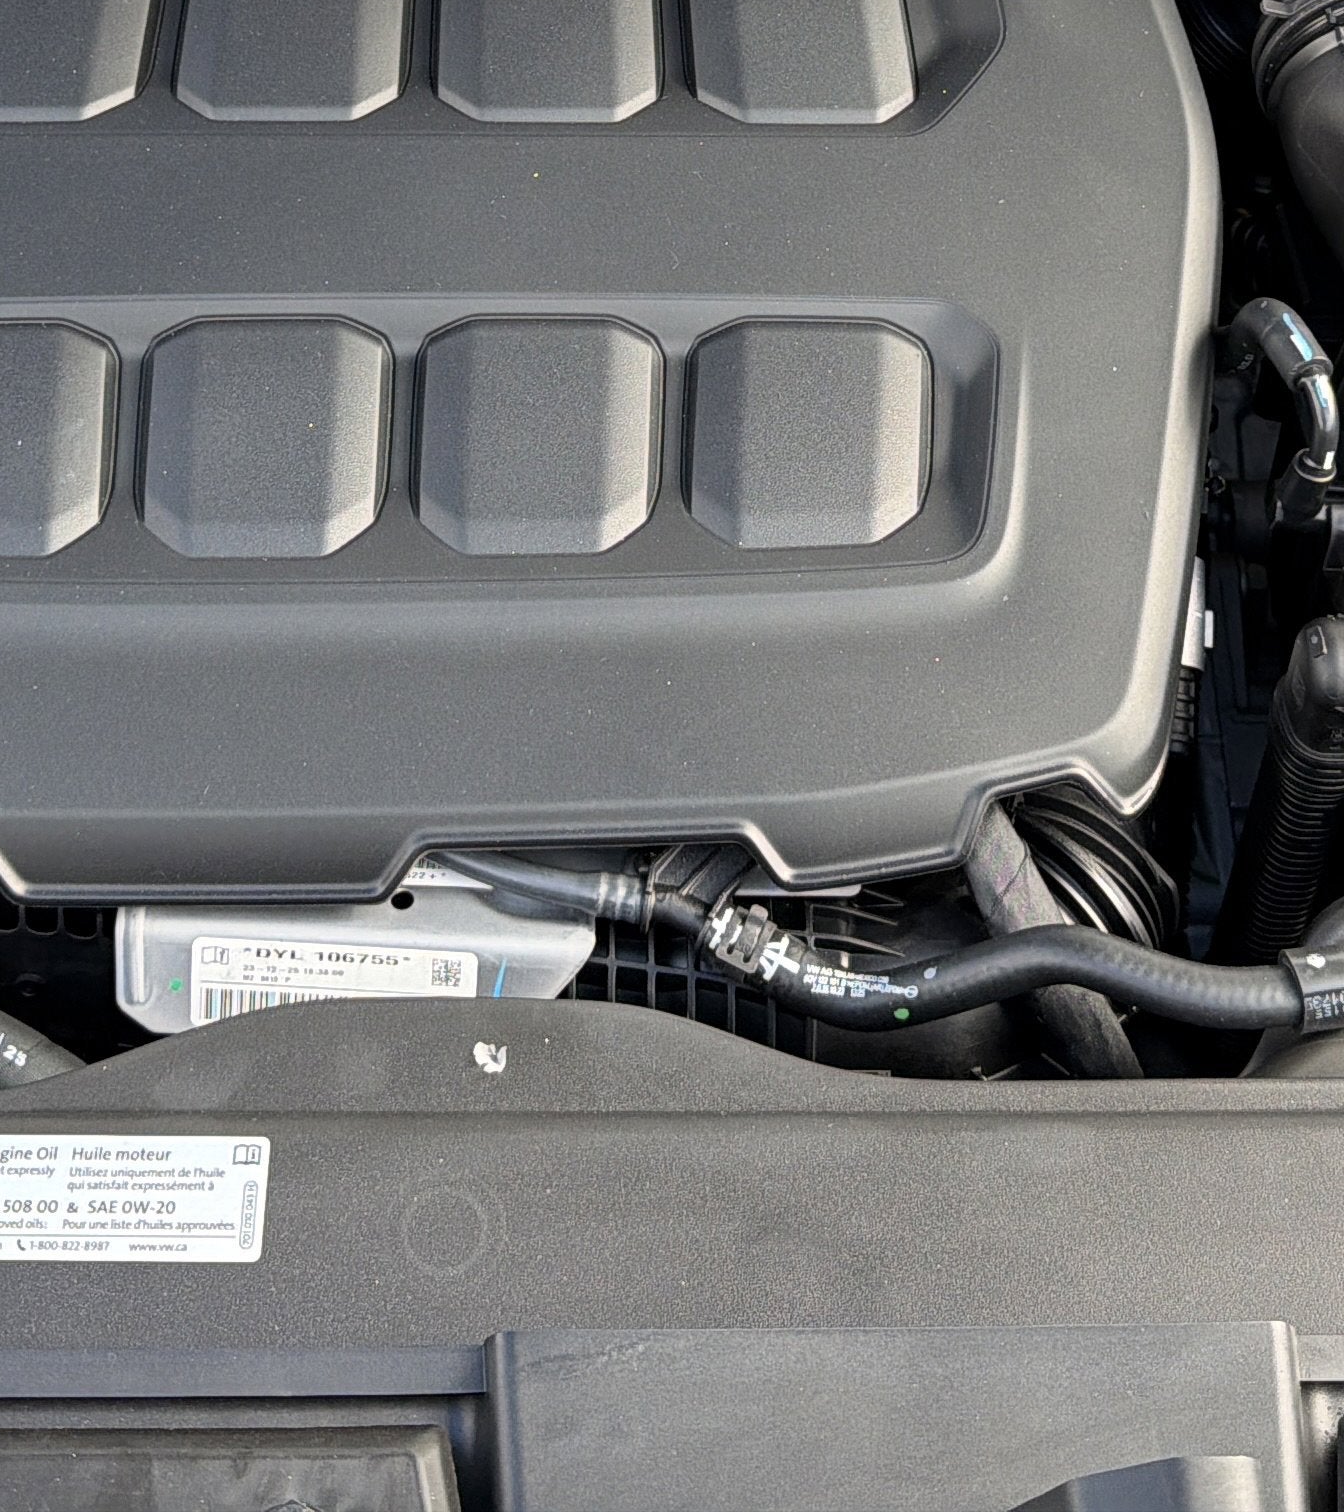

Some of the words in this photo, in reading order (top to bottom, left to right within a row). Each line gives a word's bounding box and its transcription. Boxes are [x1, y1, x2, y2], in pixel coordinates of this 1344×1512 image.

[37, 1146, 58, 1160] Oil
[71, 1147, 111, 1161] Huile
[115, 1149, 172, 1161] moteur
[7, 1165, 56, 1179] expressly
[69, 1167, 108, 1178] Utilisez
[110, 1167, 175, 1182] uniquement
[178, 1168, 192, 1178] de
[67, 1181, 85, 1193] qui
[87, 1180, 129, 1191] satisfait
[131, 1181, 202, 1194] expressément
[207, 1180, 214, 1191] à
[3, 1199, 33, 1214] 508
[37, 1199, 59, 1214] 00
[67, 1201, 79, 1214] &
[87, 1200, 118, 1214] SAE
[122, 1201, 176, 1215] 0W-20
[62, 1219, 86, 1230] Pour
[88, 1220, 108, 1230] une
[111, 1219, 131, 1230] liste
[129, 1242, 187, 1252] www.vw.ca
